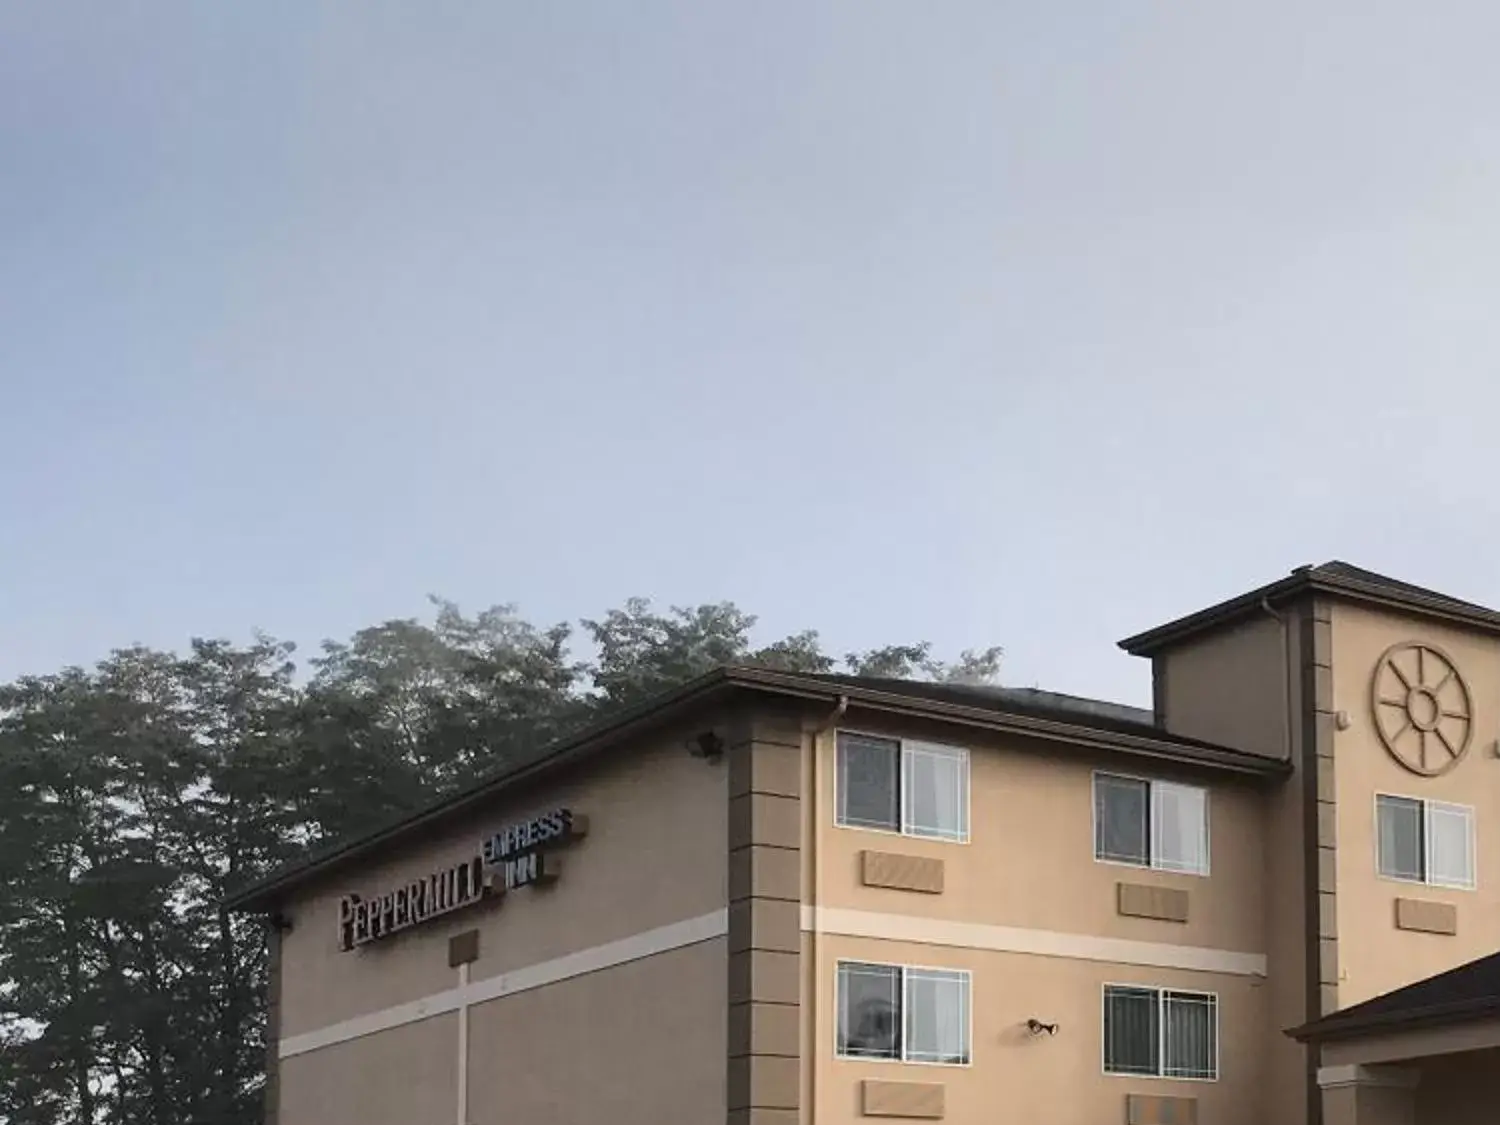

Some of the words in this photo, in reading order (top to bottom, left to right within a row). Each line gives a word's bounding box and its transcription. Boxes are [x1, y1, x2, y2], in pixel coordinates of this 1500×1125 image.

[480, 808, 573, 865] EMPRESS
[504, 853, 543, 889] INN
[337, 856, 483, 951] PEPPERMILL
